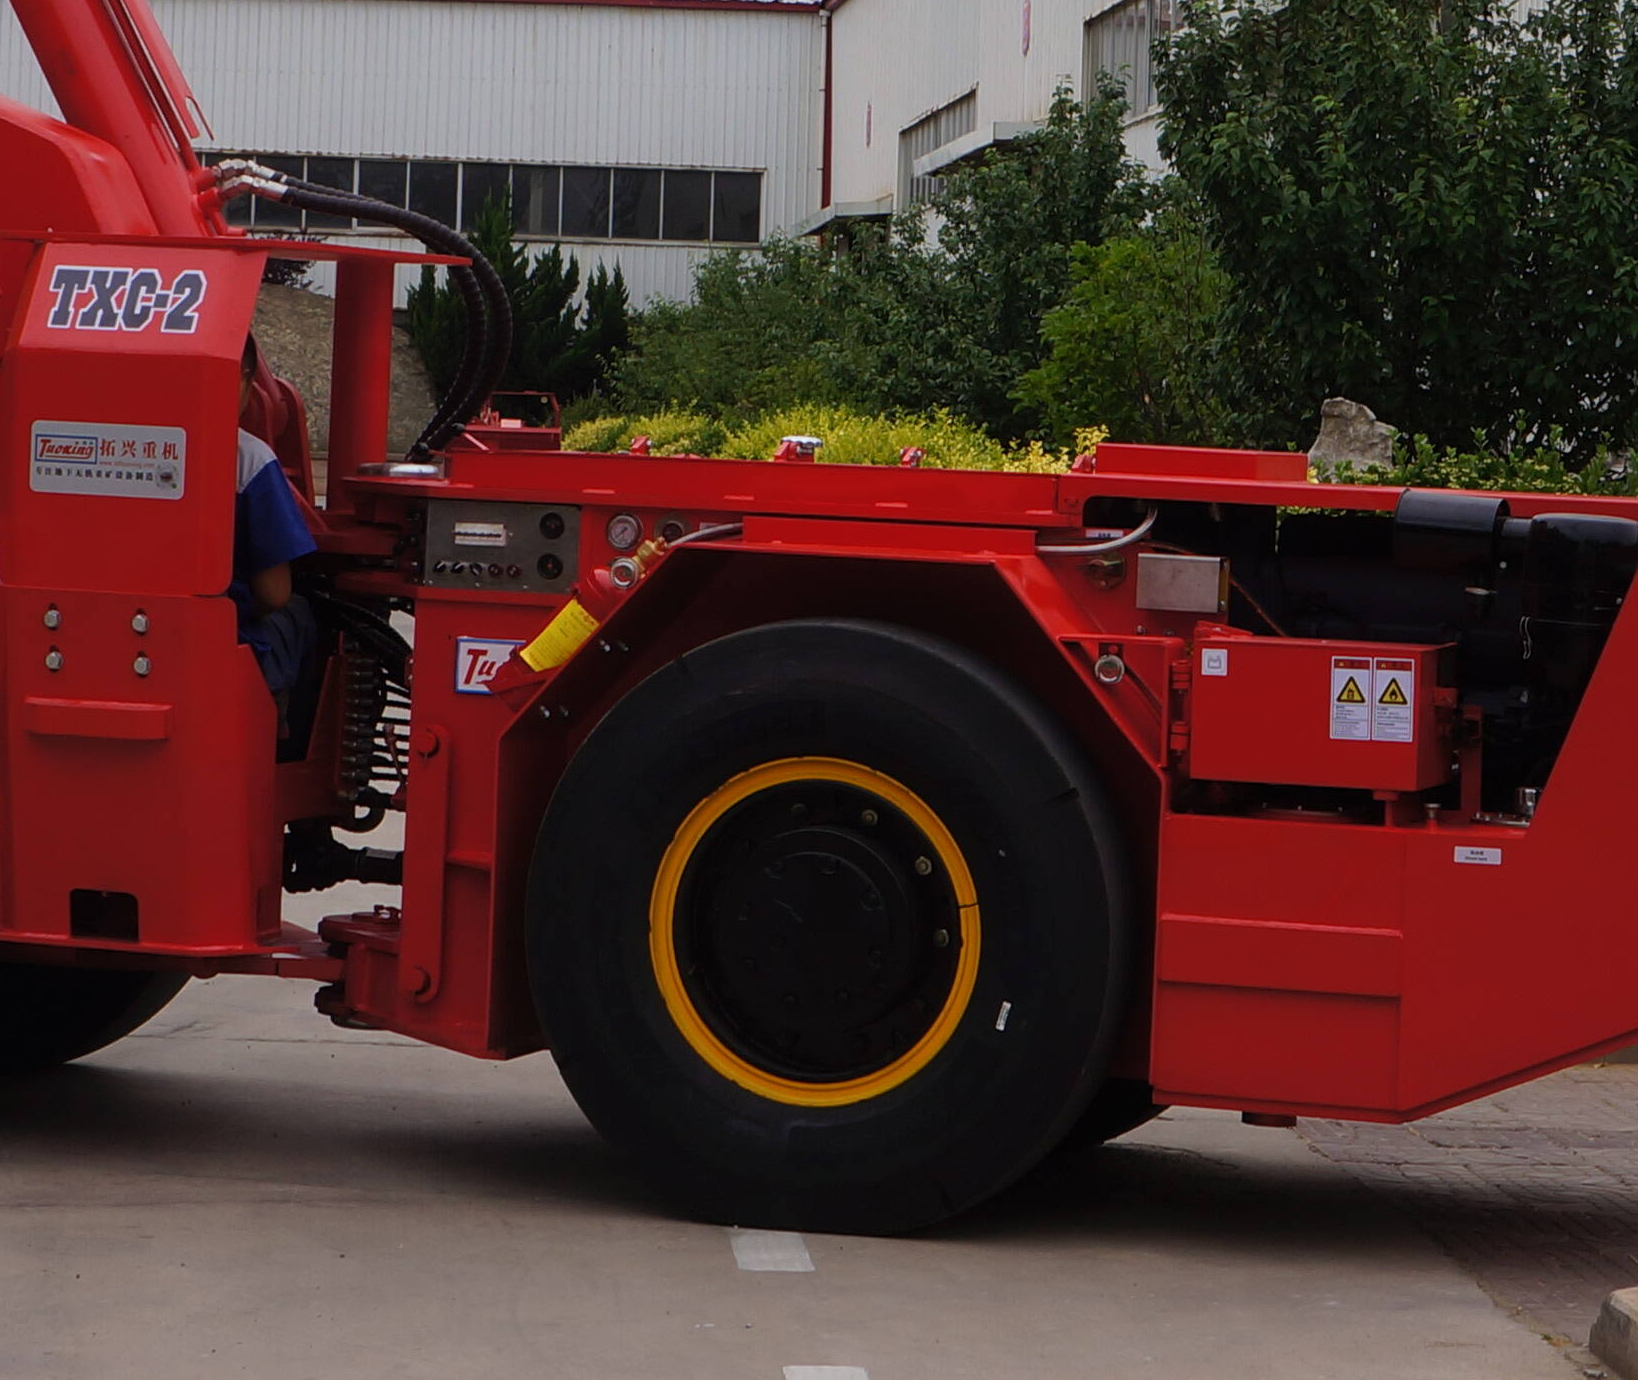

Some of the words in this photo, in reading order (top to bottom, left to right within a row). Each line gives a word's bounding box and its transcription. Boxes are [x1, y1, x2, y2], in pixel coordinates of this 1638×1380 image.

[48, 265, 207, 333] TXC-2
[39, 438, 94, 460] Tuoxing
[99, 438, 179, 461] 拓兴重机
